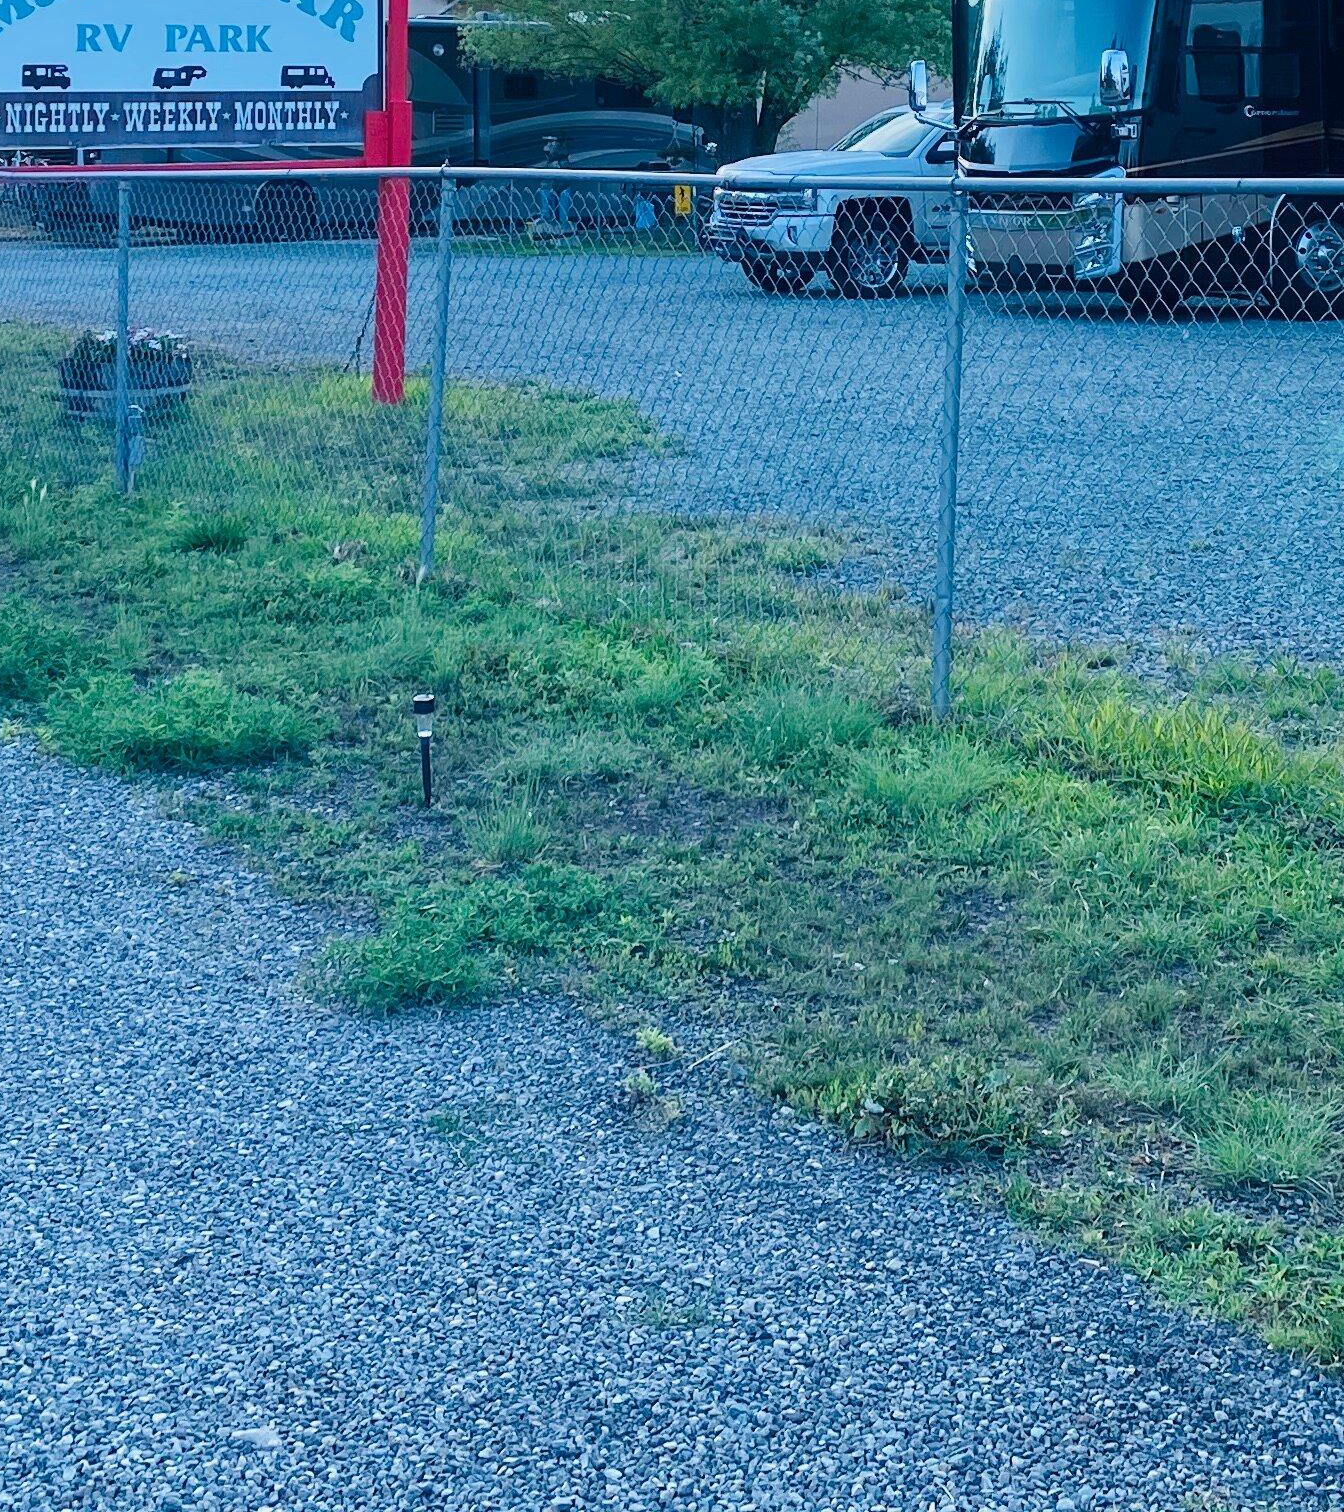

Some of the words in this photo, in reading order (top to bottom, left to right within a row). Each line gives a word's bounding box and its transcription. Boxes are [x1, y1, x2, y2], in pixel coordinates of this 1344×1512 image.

[76, 23, 134, 53] RV
[164, 24, 273, 53] PARK
[6, 102, 110, 133] NIGHTLY
[123, 101, 222, 132] WEEKLY
[234, 100, 340, 131] MONTHLY
